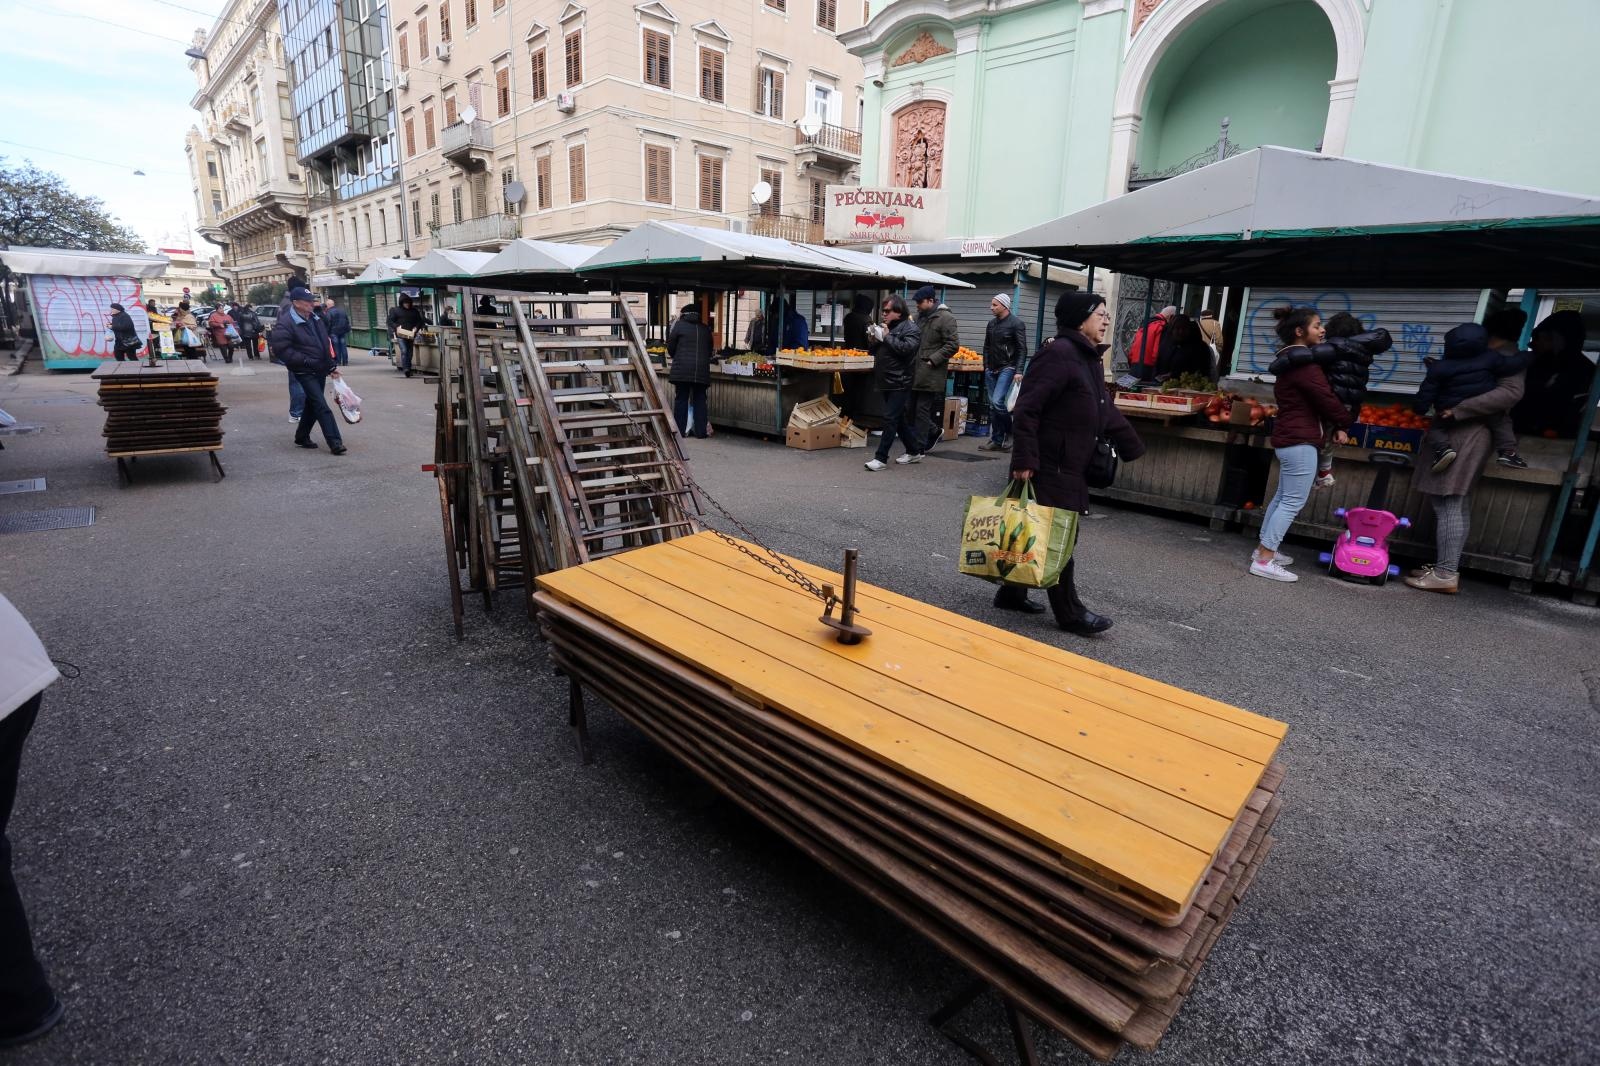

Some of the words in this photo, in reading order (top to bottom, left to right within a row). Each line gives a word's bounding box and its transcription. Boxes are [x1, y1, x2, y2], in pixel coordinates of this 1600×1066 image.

[834, 187, 924, 209] PEČENJARA
[880, 245, 907, 255] JAJA
[1374, 439, 1412, 452] RADA
[966, 528, 995, 542] CORN
